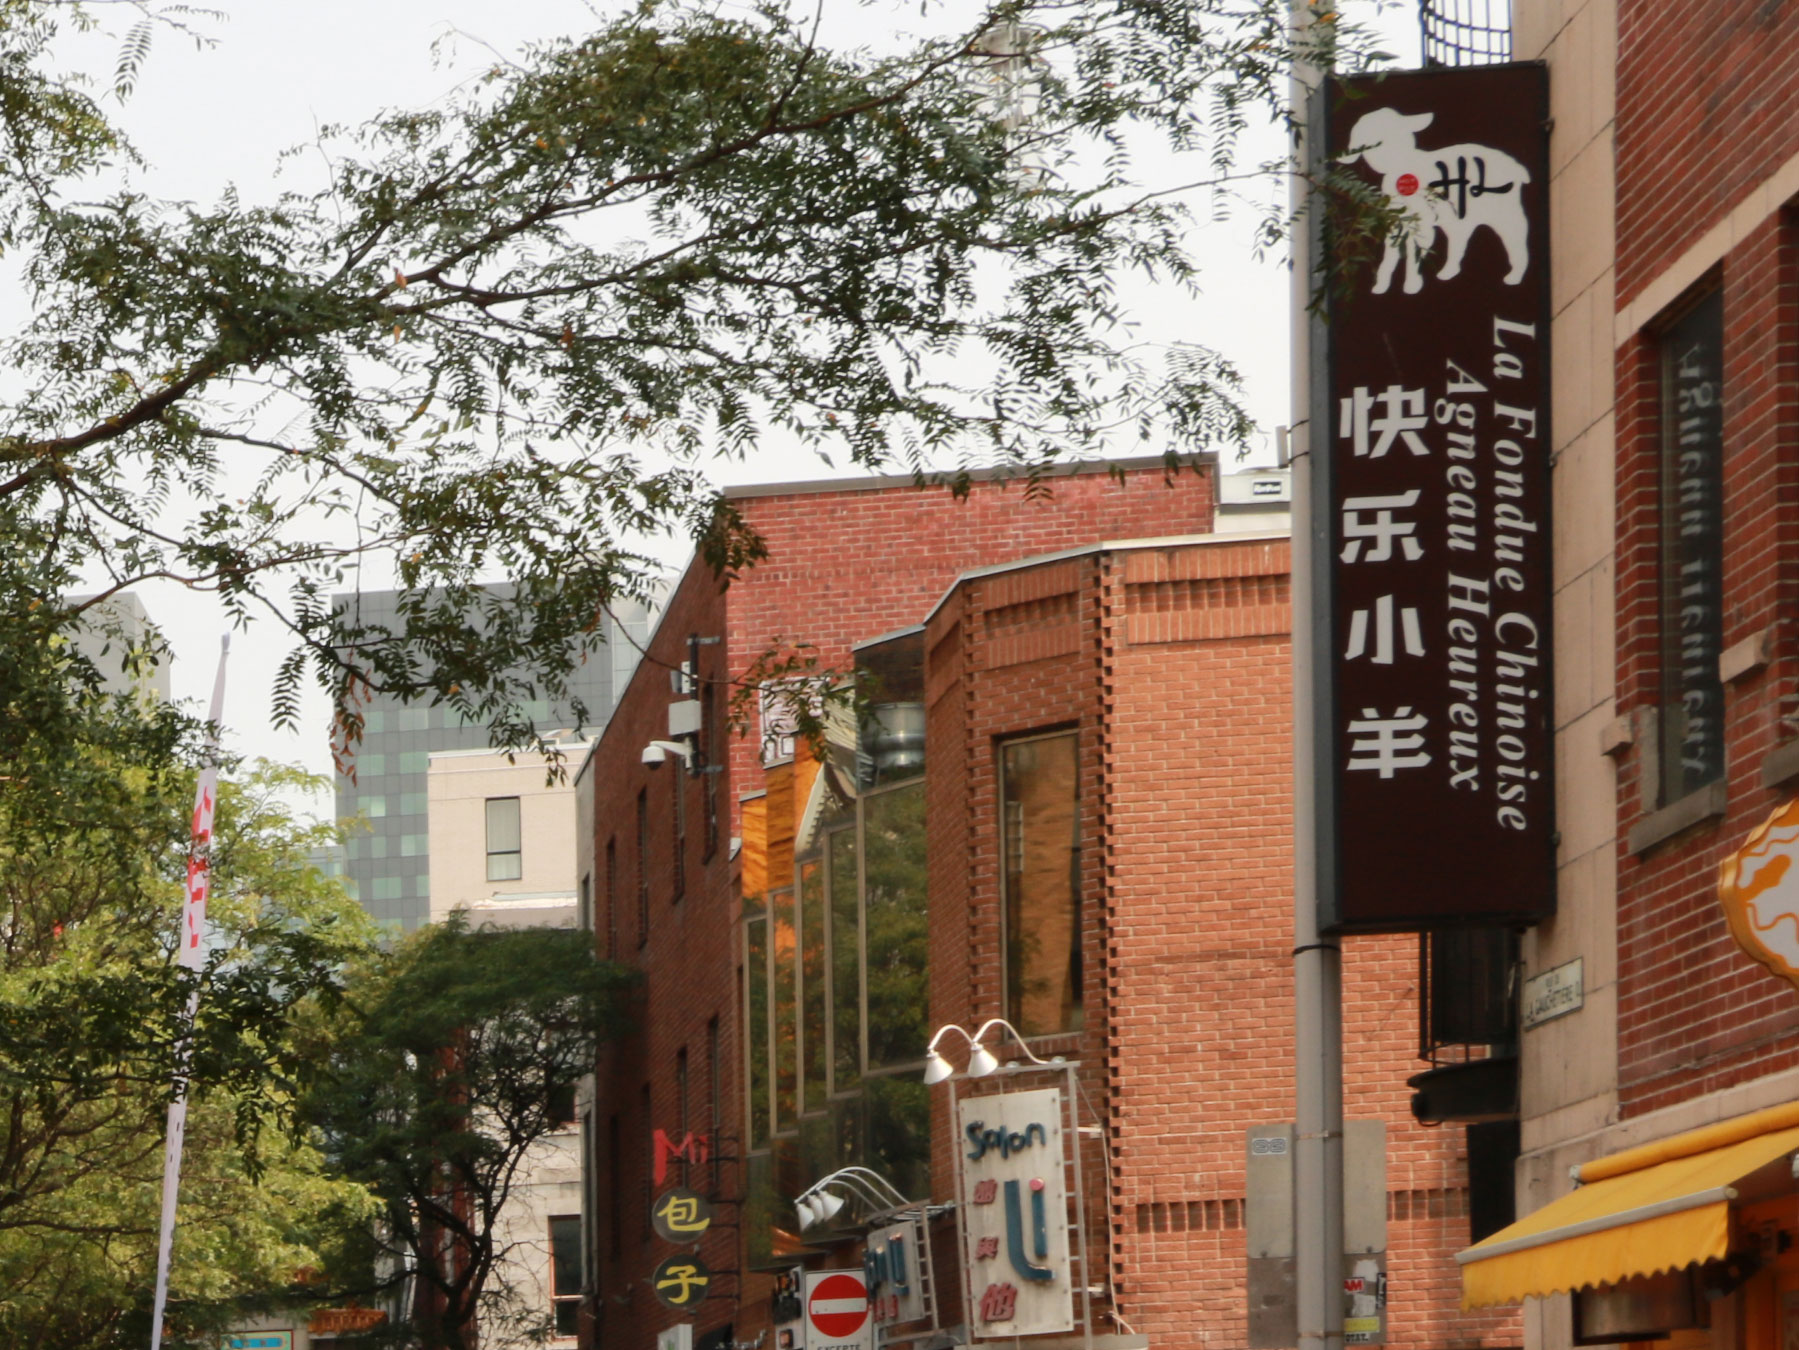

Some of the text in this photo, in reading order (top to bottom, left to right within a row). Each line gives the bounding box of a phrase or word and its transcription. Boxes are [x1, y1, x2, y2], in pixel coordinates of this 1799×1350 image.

[1339, 384, 1433, 779] 快乐小羊
[1435, 358, 1491, 792] Agneau Heureux
[1493, 314, 1539, 831] La Fondue Chinoise
[656, 1194, 711, 1304] 包子
[966, 1121, 1047, 1162] Salon
